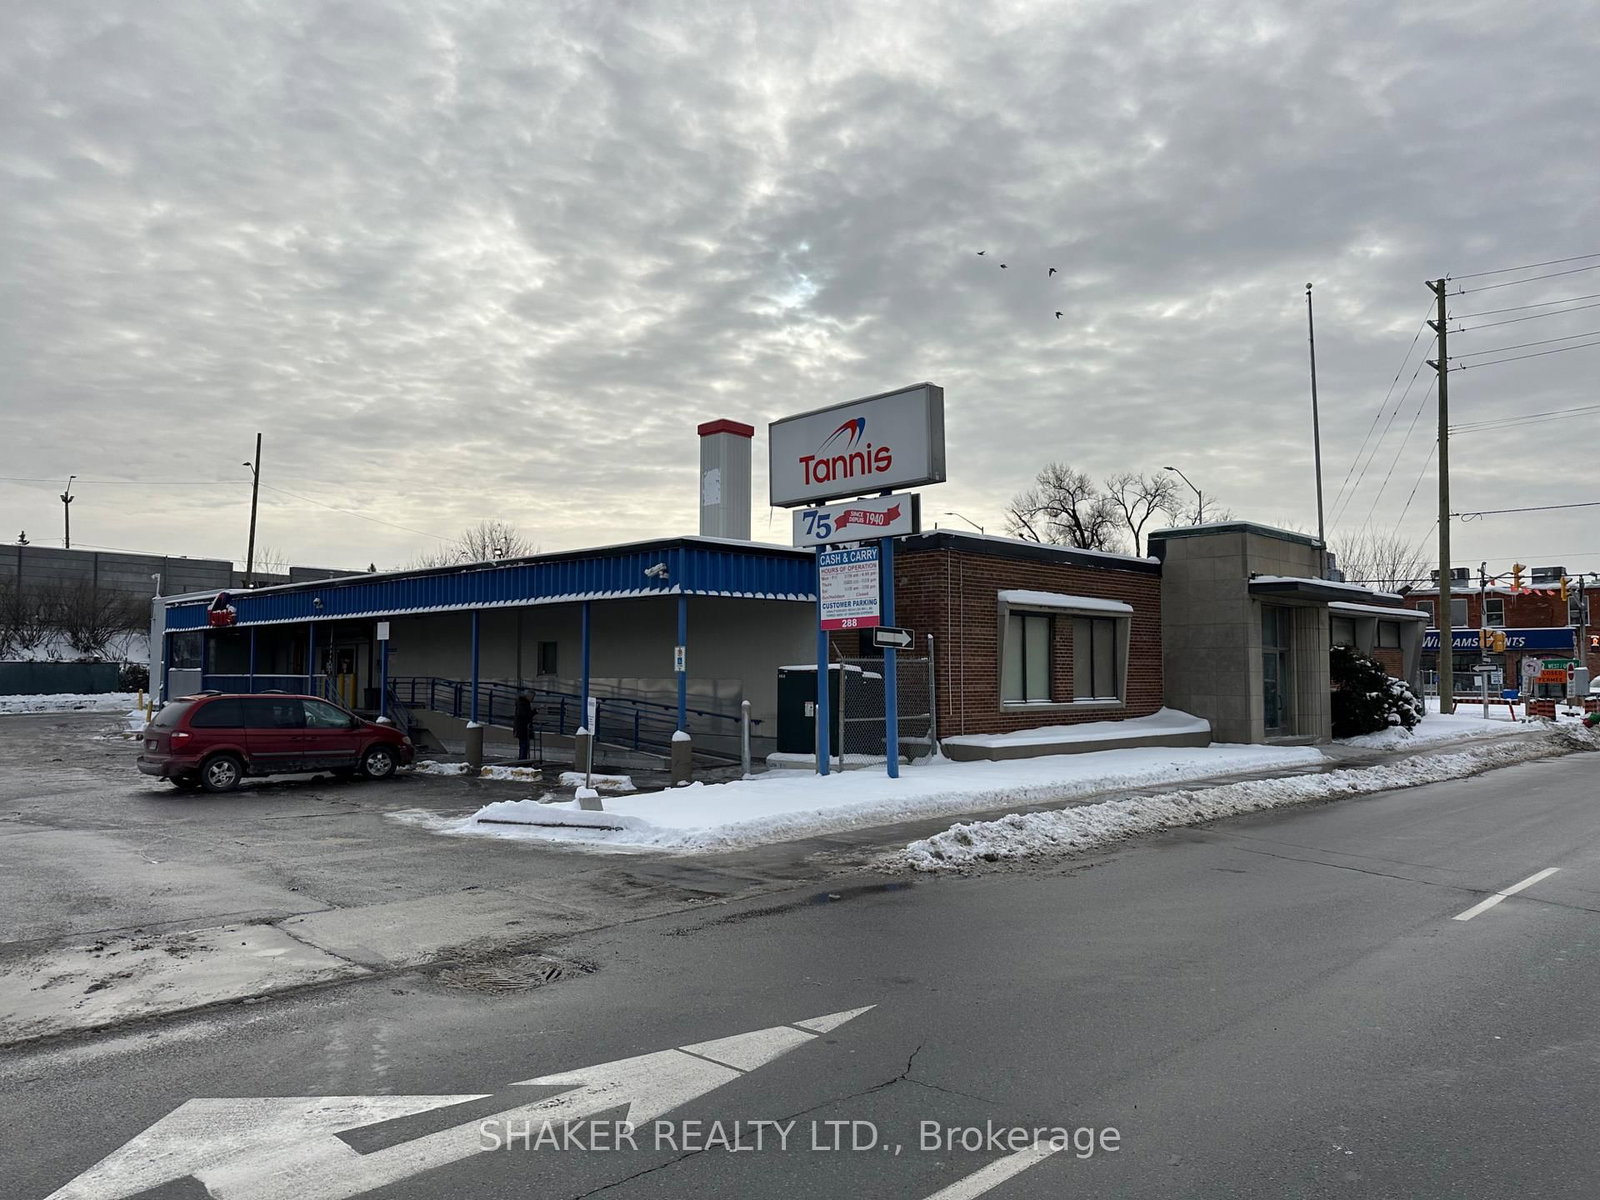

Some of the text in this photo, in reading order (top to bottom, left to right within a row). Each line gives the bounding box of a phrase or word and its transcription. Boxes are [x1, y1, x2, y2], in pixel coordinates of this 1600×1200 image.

[799, 442, 892, 485] Tannis
[803, 510, 832, 539] 75
[866, 513, 884, 525] 1940
[820, 549, 878, 566] CASH & CARRY
[821, 566, 839, 574] HOURS
[847, 562, 877, 572] OPERATION
[822, 599, 877, 609] CUSTOMER PARKING
[841, 619, 858, 628] 288
